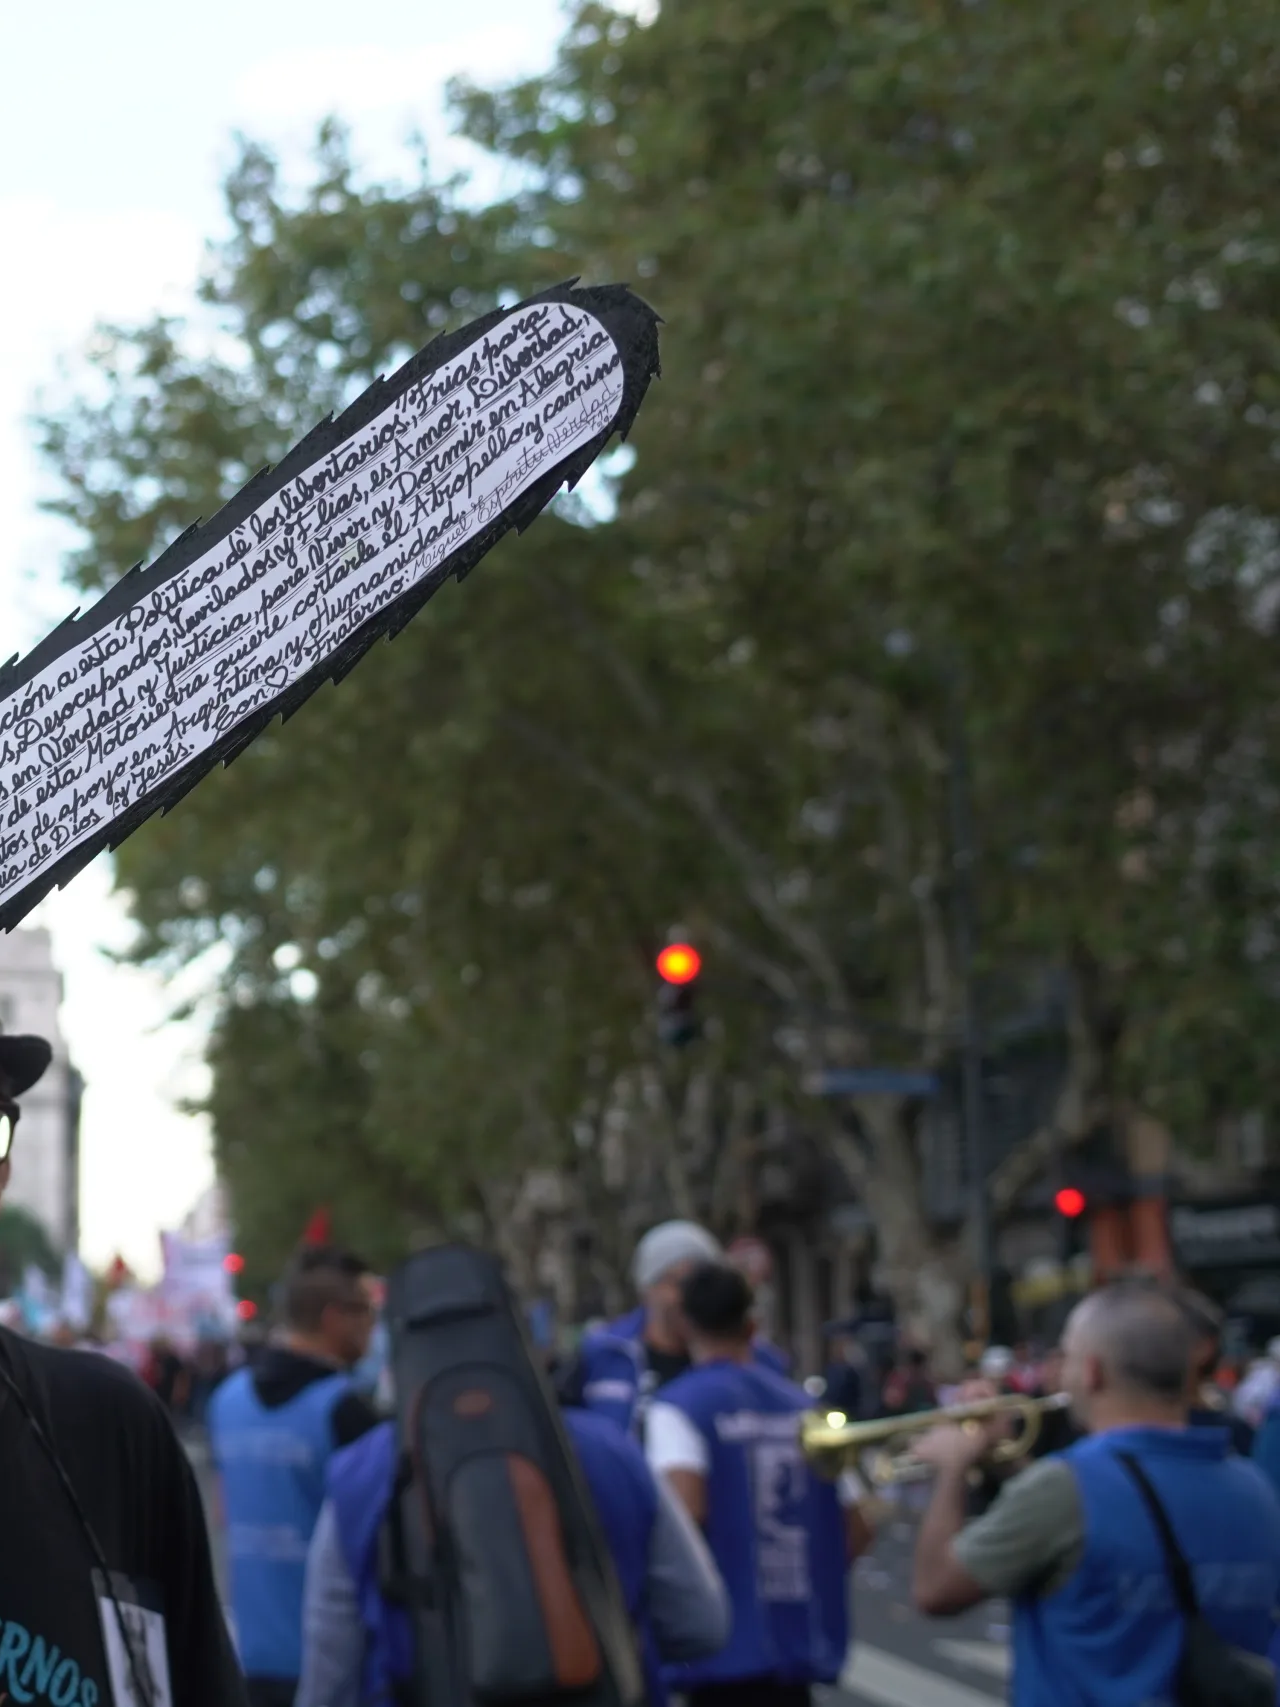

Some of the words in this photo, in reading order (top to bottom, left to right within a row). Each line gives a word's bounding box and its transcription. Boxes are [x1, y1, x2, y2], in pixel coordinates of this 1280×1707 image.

[7, 795, 32, 828] de
[35, 758, 82, 807] esta
[82, 673, 209, 773] Motosierra
[213, 615, 288, 691] quiere
[292, 537, 379, 621] cortarle
[382, 510, 410, 549] el
[410, 422, 526, 527] Atropello
[521, 413, 543, 444] y
[543, 353, 620, 423] camino
[12, 764, 41, 793] en
[38, 687, 135, 768] Verdad
[137, 674, 158, 707] y
[260, 565, 309, 625] para
[307, 516, 371, 570] Vivir
[372, 496, 394, 532] y
[388, 419, 485, 505] Dormir
[488, 399, 519, 431] en
[57, 668, 77, 692] a
[78, 632, 127, 677] esta
[481, 306, 548, 376] para
[273, 535, 297, 569] y
[370, 462, 393, 492] es
[390, 399, 470, 473] Amor,
[29, 840, 51, 868] de
[49, 808, 101, 850] Dios
[111, 781, 129, 807] y
[211, 688, 269, 733] Con
[413, 513, 472, 579] Miguel
[32, 811, 56, 843] de
[58, 756, 128, 823] apoyo
[130, 743, 161, 770] en
[162, 651, 286, 749] Argentina
[285, 630, 308, 667] y
